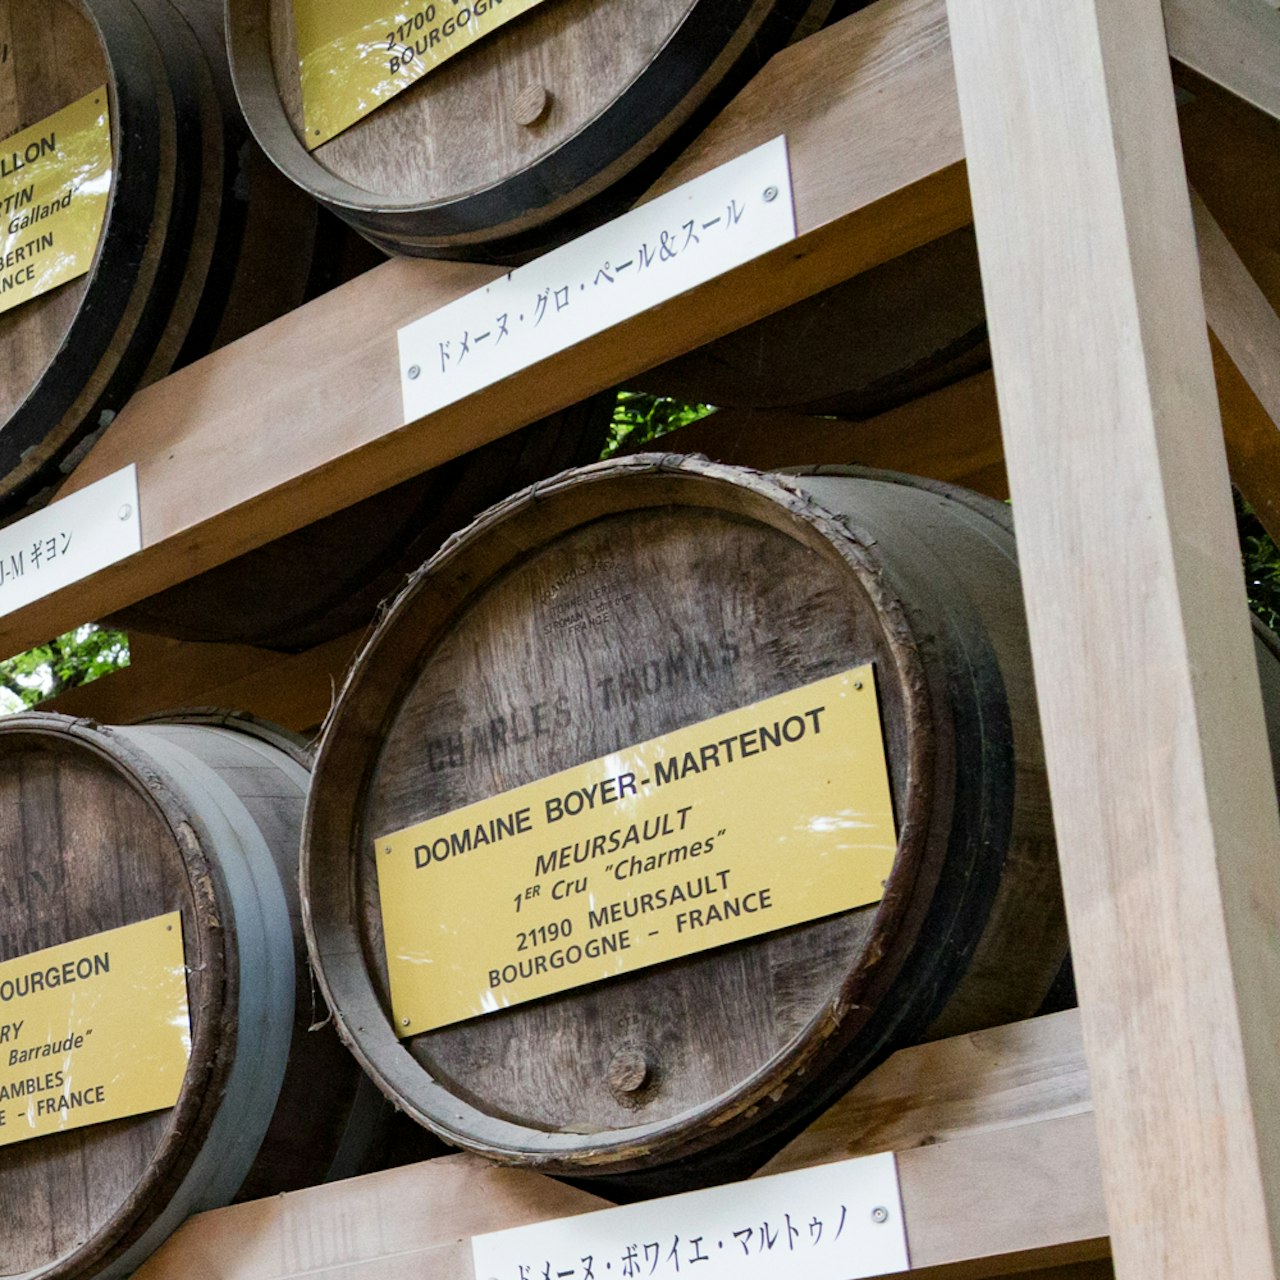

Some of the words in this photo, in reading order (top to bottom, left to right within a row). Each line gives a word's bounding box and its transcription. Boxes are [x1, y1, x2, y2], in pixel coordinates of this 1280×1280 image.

[385, 4, 436, 51] 21700
[413, 806, 533, 870] DOMAINE
[544, 705, 827, 824] BOYER-MARTENOT
[513, 884, 542, 913] 1ER
[551, 871, 588, 903] Cru
[604, 829, 727, 890] "Charmes"
[535, 806, 692, 877] MEURSAULT
[488, 931, 631, 989] BOURGOGNE
[676, 889, 772, 934] FRANCE
[517, 916, 573, 952] 21190
[588, 869, 731, 930] MEURSAULT
[8, 1028, 93, 1071] Barraude"
[37, 1086, 105, 1117] FRANCE
